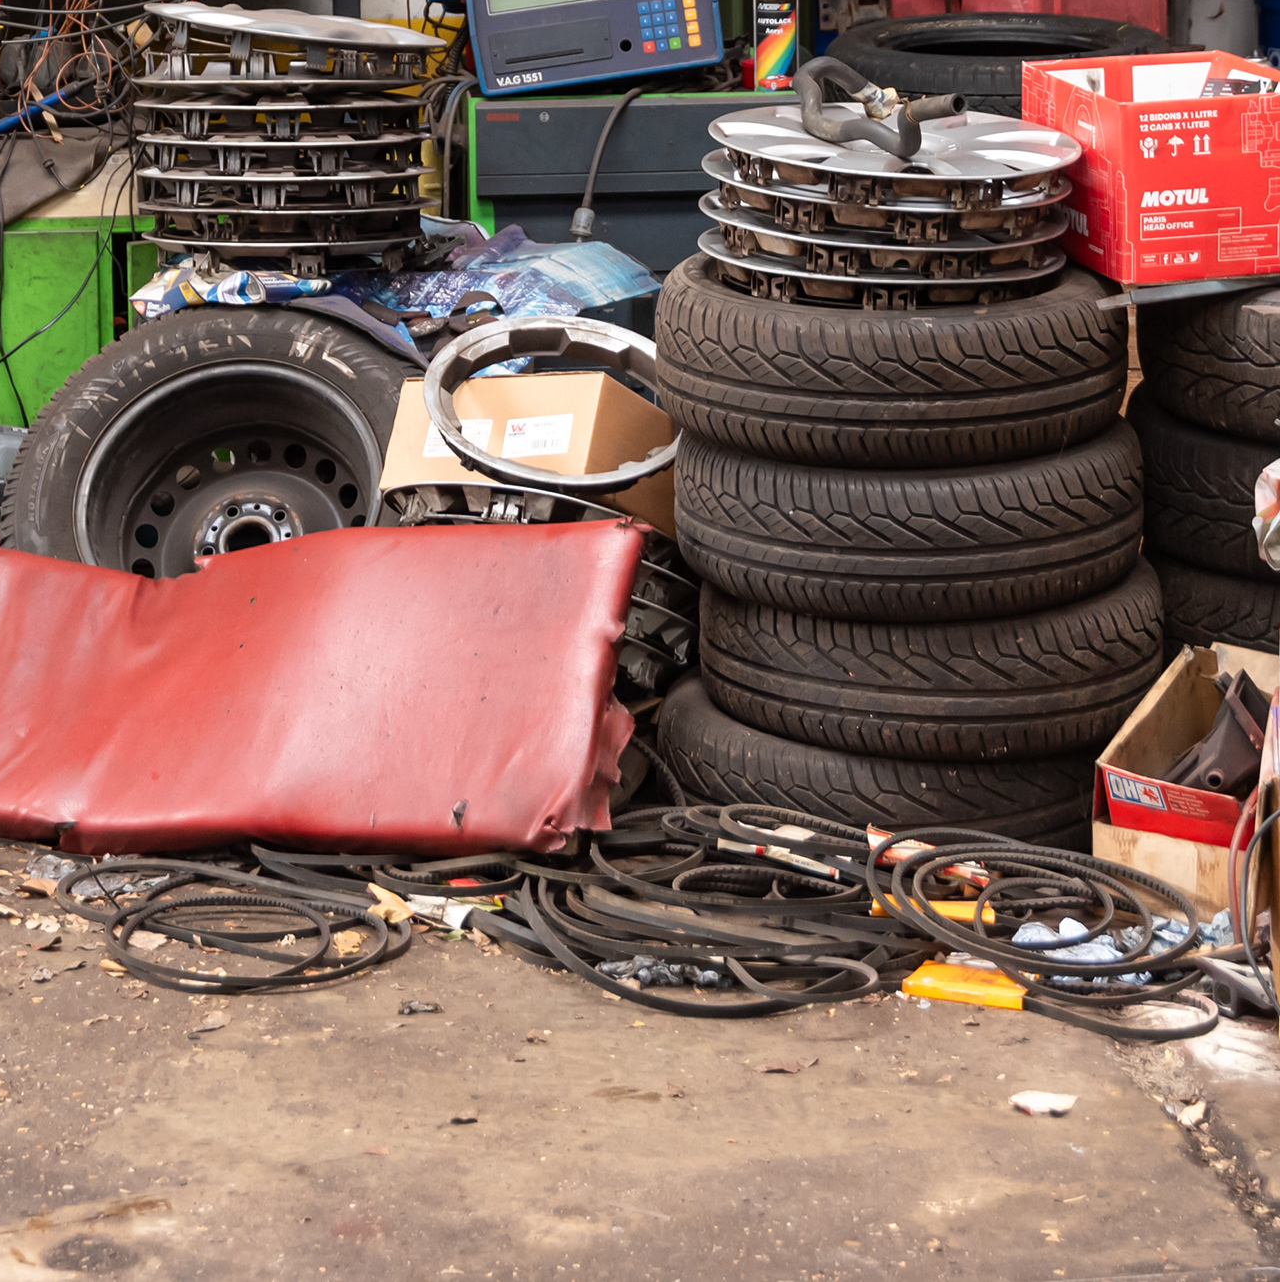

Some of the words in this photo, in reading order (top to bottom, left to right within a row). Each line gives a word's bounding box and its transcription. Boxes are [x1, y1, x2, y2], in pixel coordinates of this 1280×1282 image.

[522, 72, 543, 83] 1551
[1139, 114, 1148, 122] 12
[1150, 111, 1182, 121] BIDONS
[1182, 111, 1189, 119] X
[1195, 109, 1218, 119] LITRE
[1139, 124, 1149, 132] 12
[1150, 122, 1173, 131] CANS
[1174, 122, 1181, 130] X
[1187, 120, 1210, 129] LITER
[1140, 188, 1209, 208] MOTUL
[1143, 216, 1166, 224] PARIS
[1143, 223, 1165, 232] HEAD
[1166, 221, 1194, 230] OFFICE
